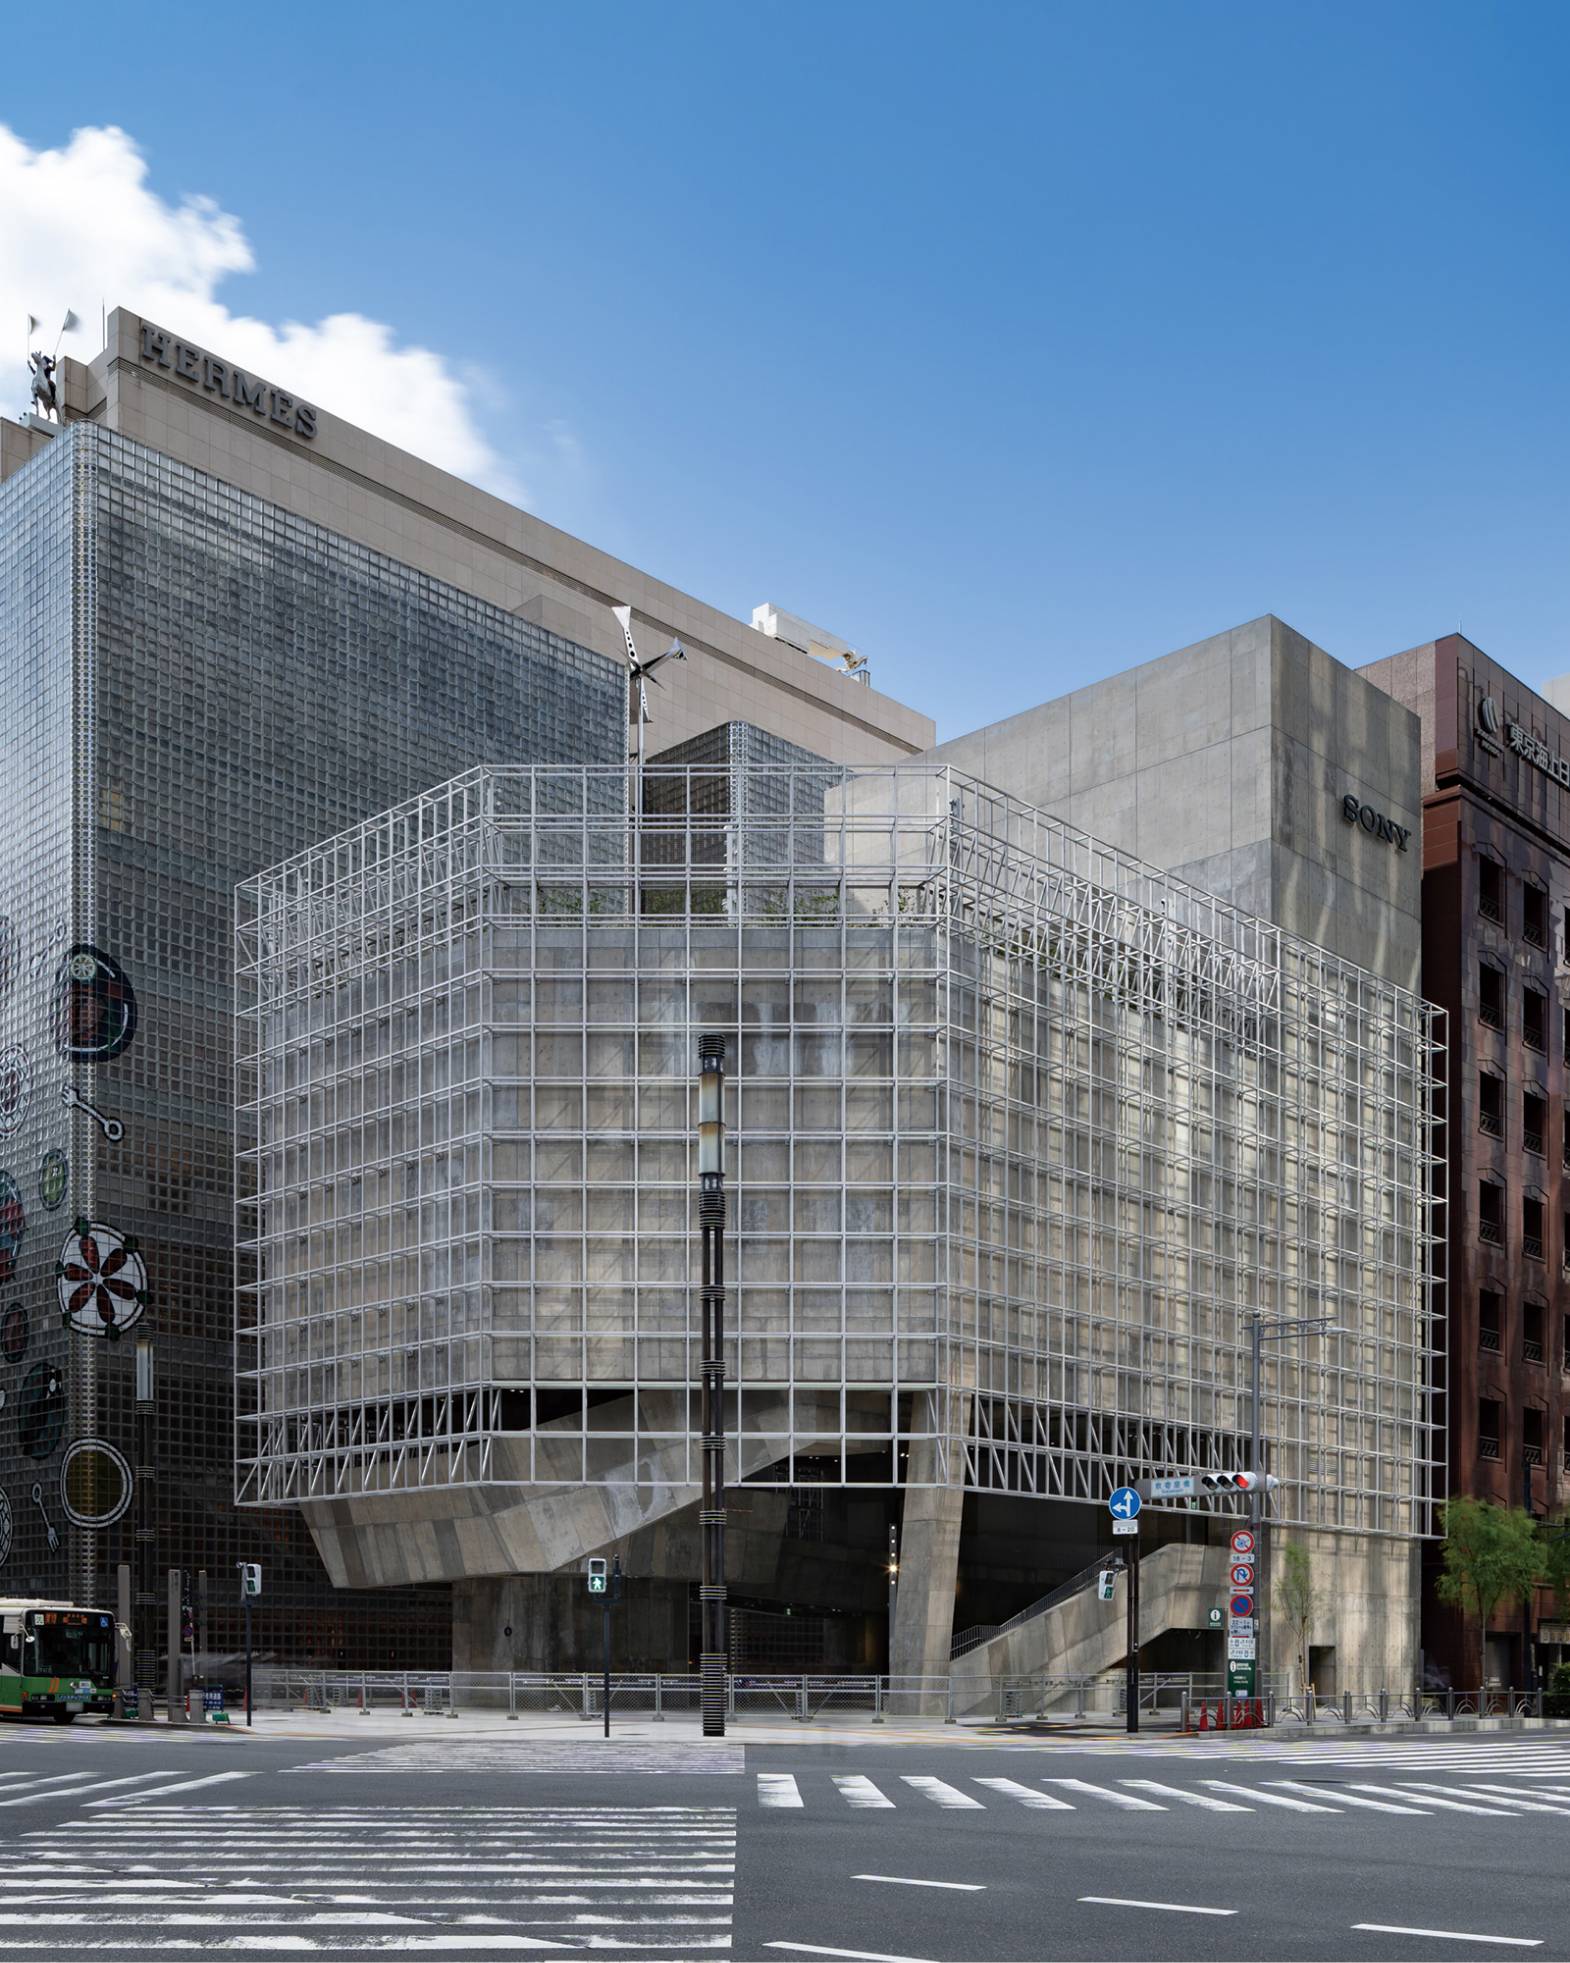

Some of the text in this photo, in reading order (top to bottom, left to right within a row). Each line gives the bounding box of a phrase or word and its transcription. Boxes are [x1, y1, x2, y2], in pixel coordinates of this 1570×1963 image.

[1509, 722, 1570, 787] 東京海上日
[1343, 794, 1412, 853] SONY
